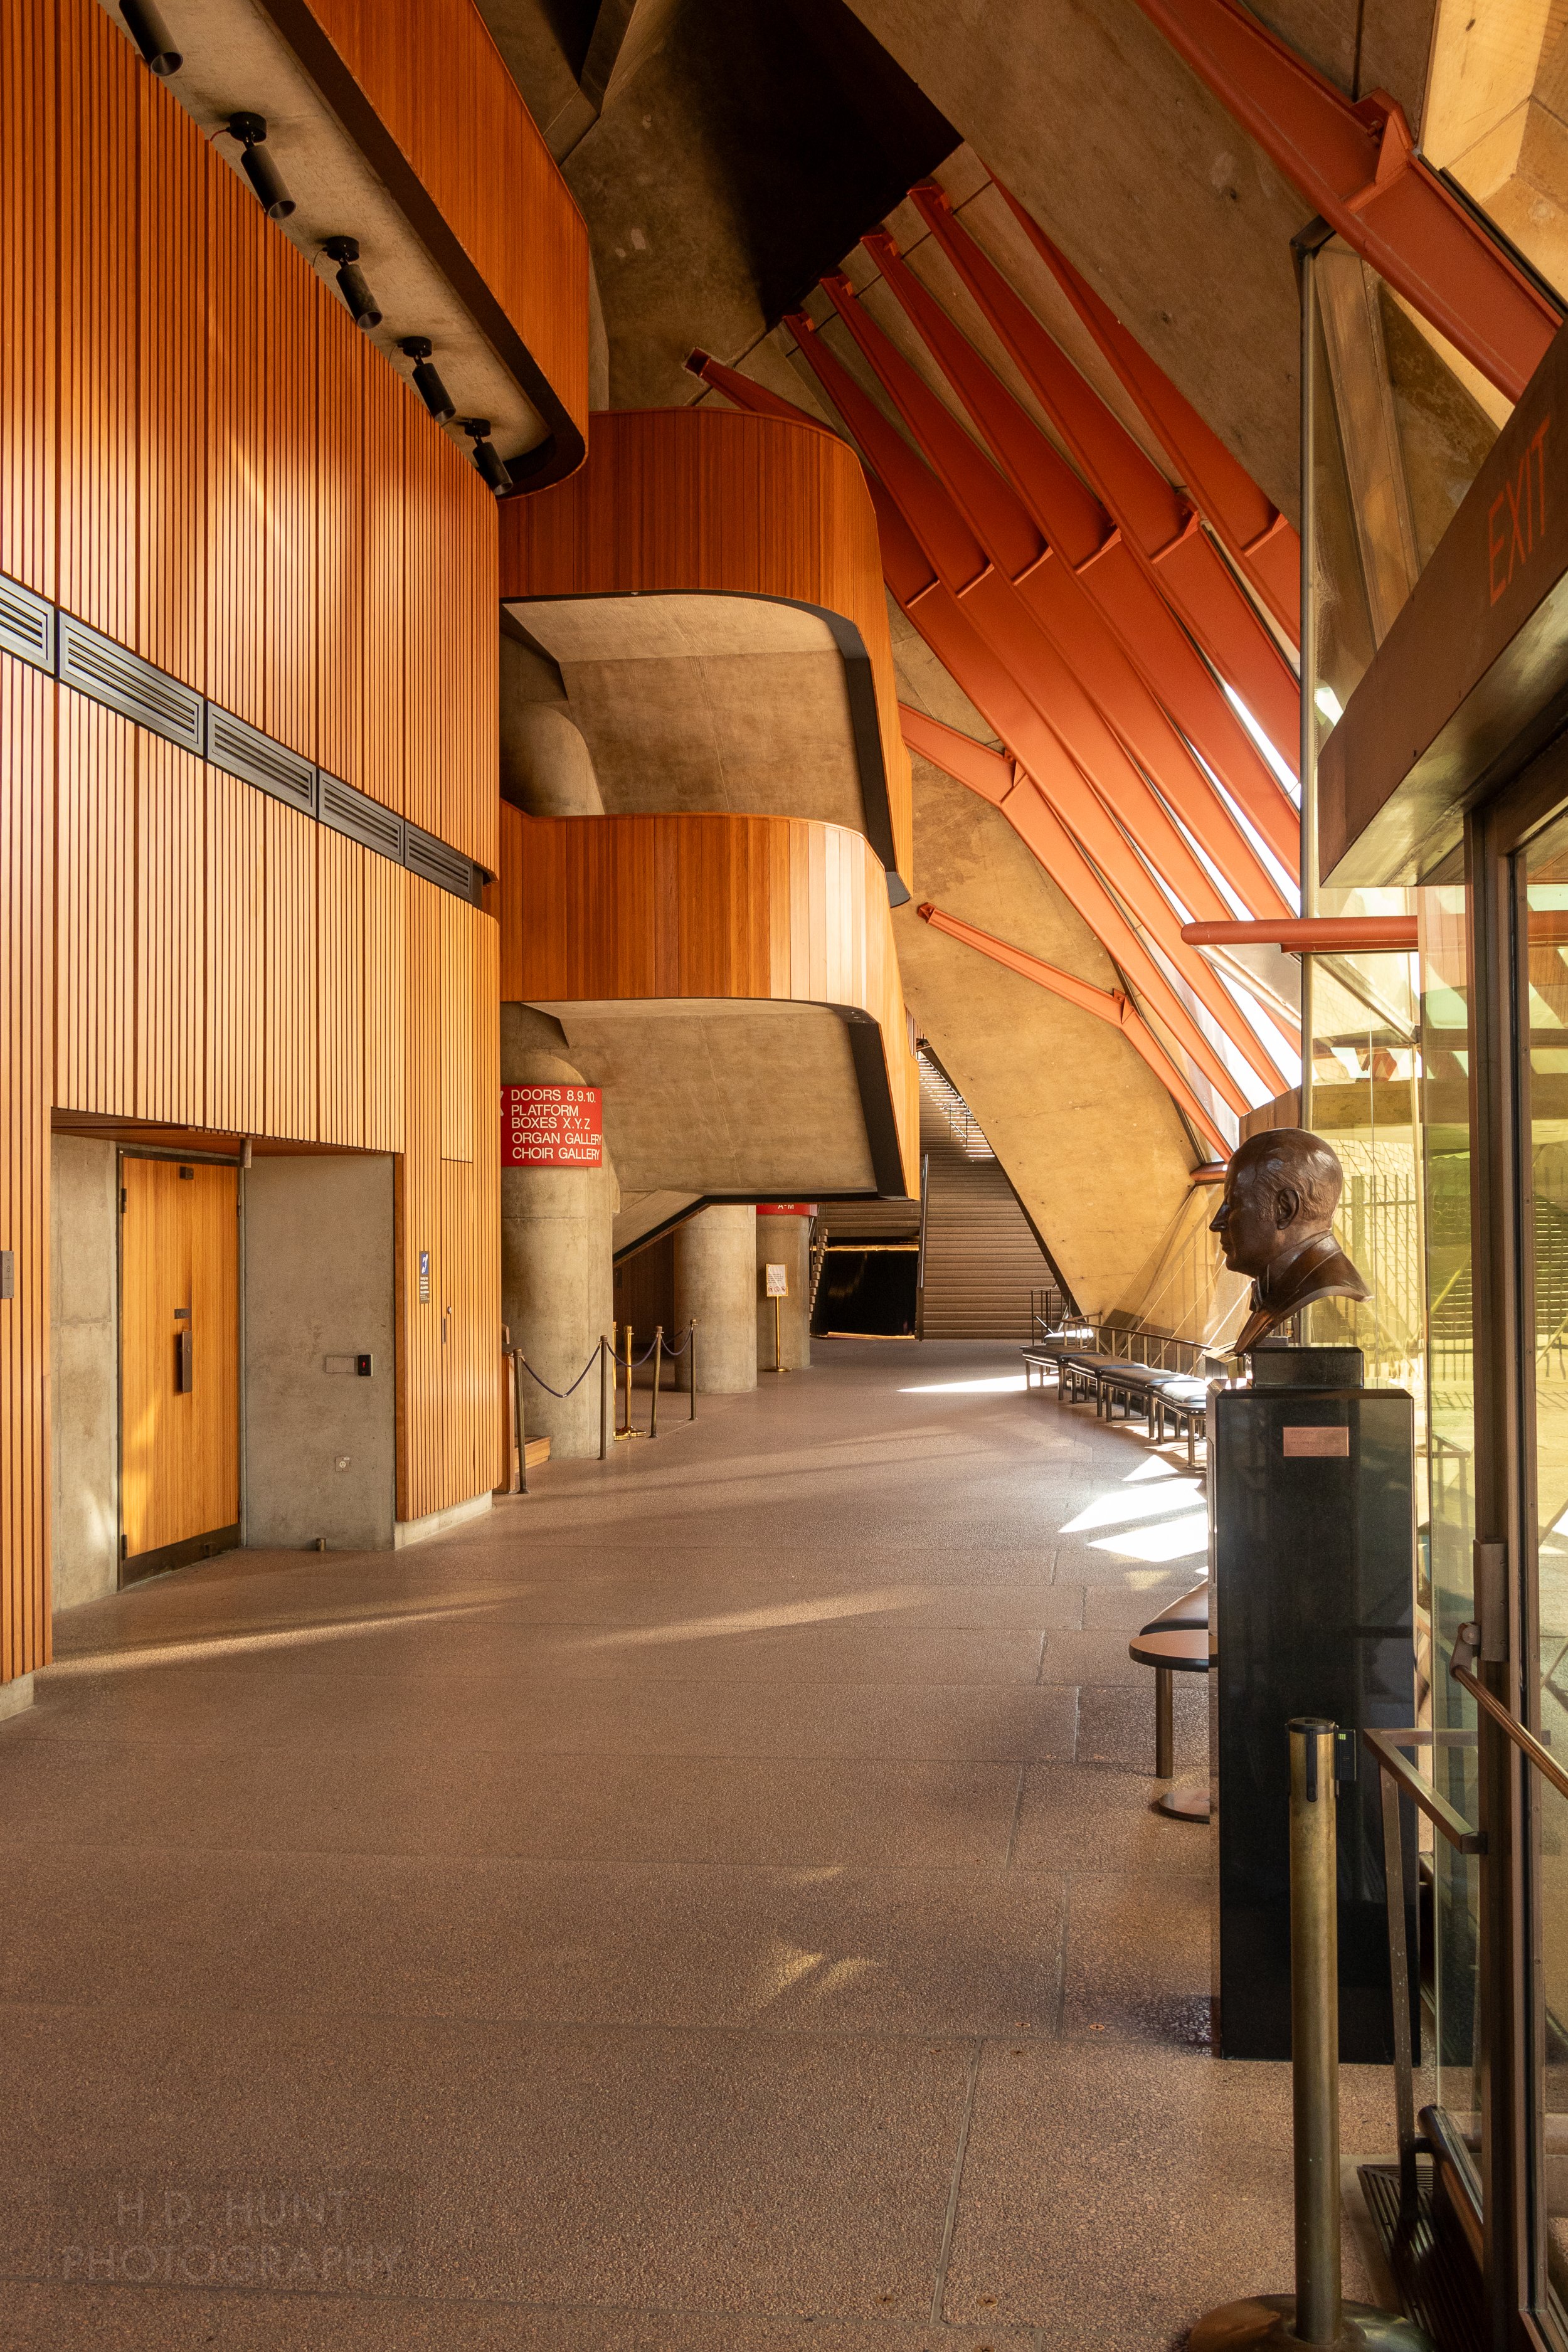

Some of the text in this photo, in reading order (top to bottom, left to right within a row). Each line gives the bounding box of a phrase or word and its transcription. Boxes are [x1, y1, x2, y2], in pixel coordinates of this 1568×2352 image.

[1488, 412, 1550, 606] EXIT
[511, 1089, 561, 1101] DOORS
[511, 1104, 579, 1116] PLATFORM
[511, 1117, 591, 1130] BOXES X.Y.Z
[512, 1132, 602, 1146] ORGAN GALLERY
[512, 1147, 600, 1160] CHOIR GALLERY
